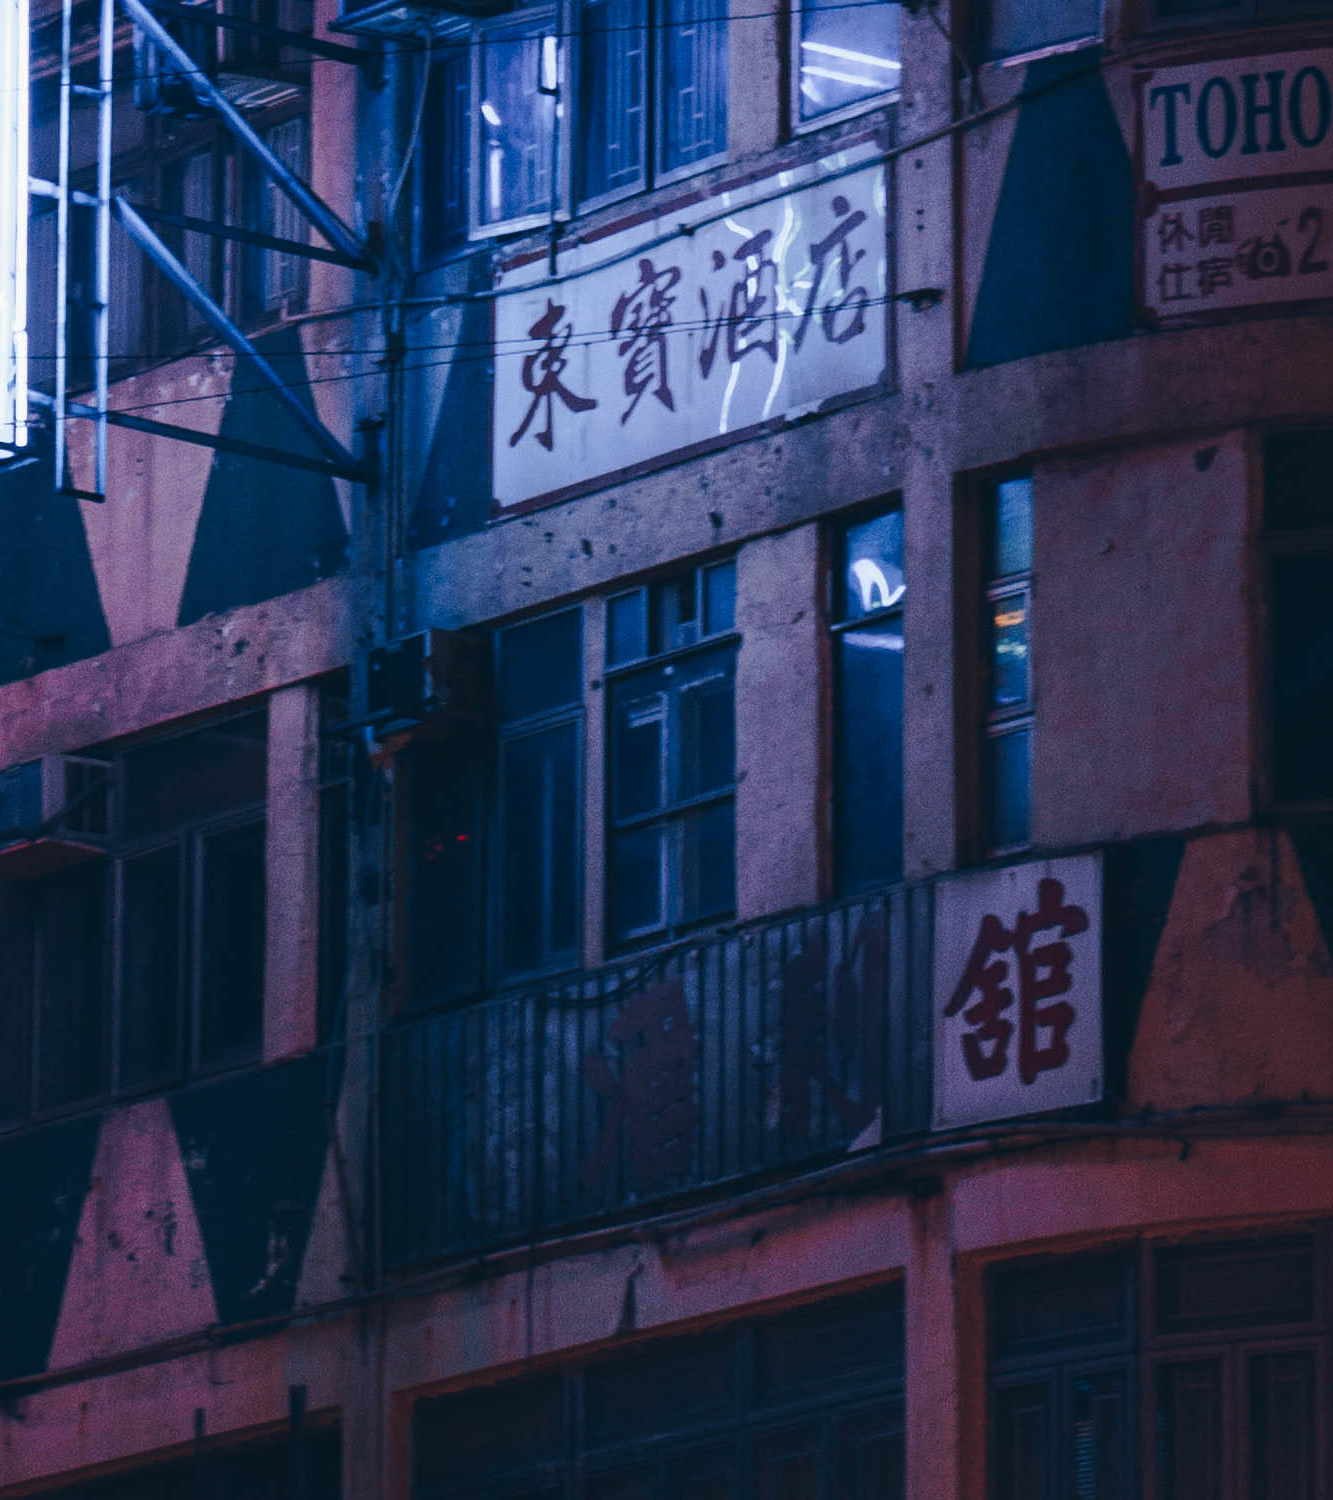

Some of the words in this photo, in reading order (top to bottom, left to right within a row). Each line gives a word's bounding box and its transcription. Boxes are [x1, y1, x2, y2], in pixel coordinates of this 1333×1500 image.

[1151, 65, 1332, 167] TOHO
[509, 195, 869, 452] 東寶酒店
